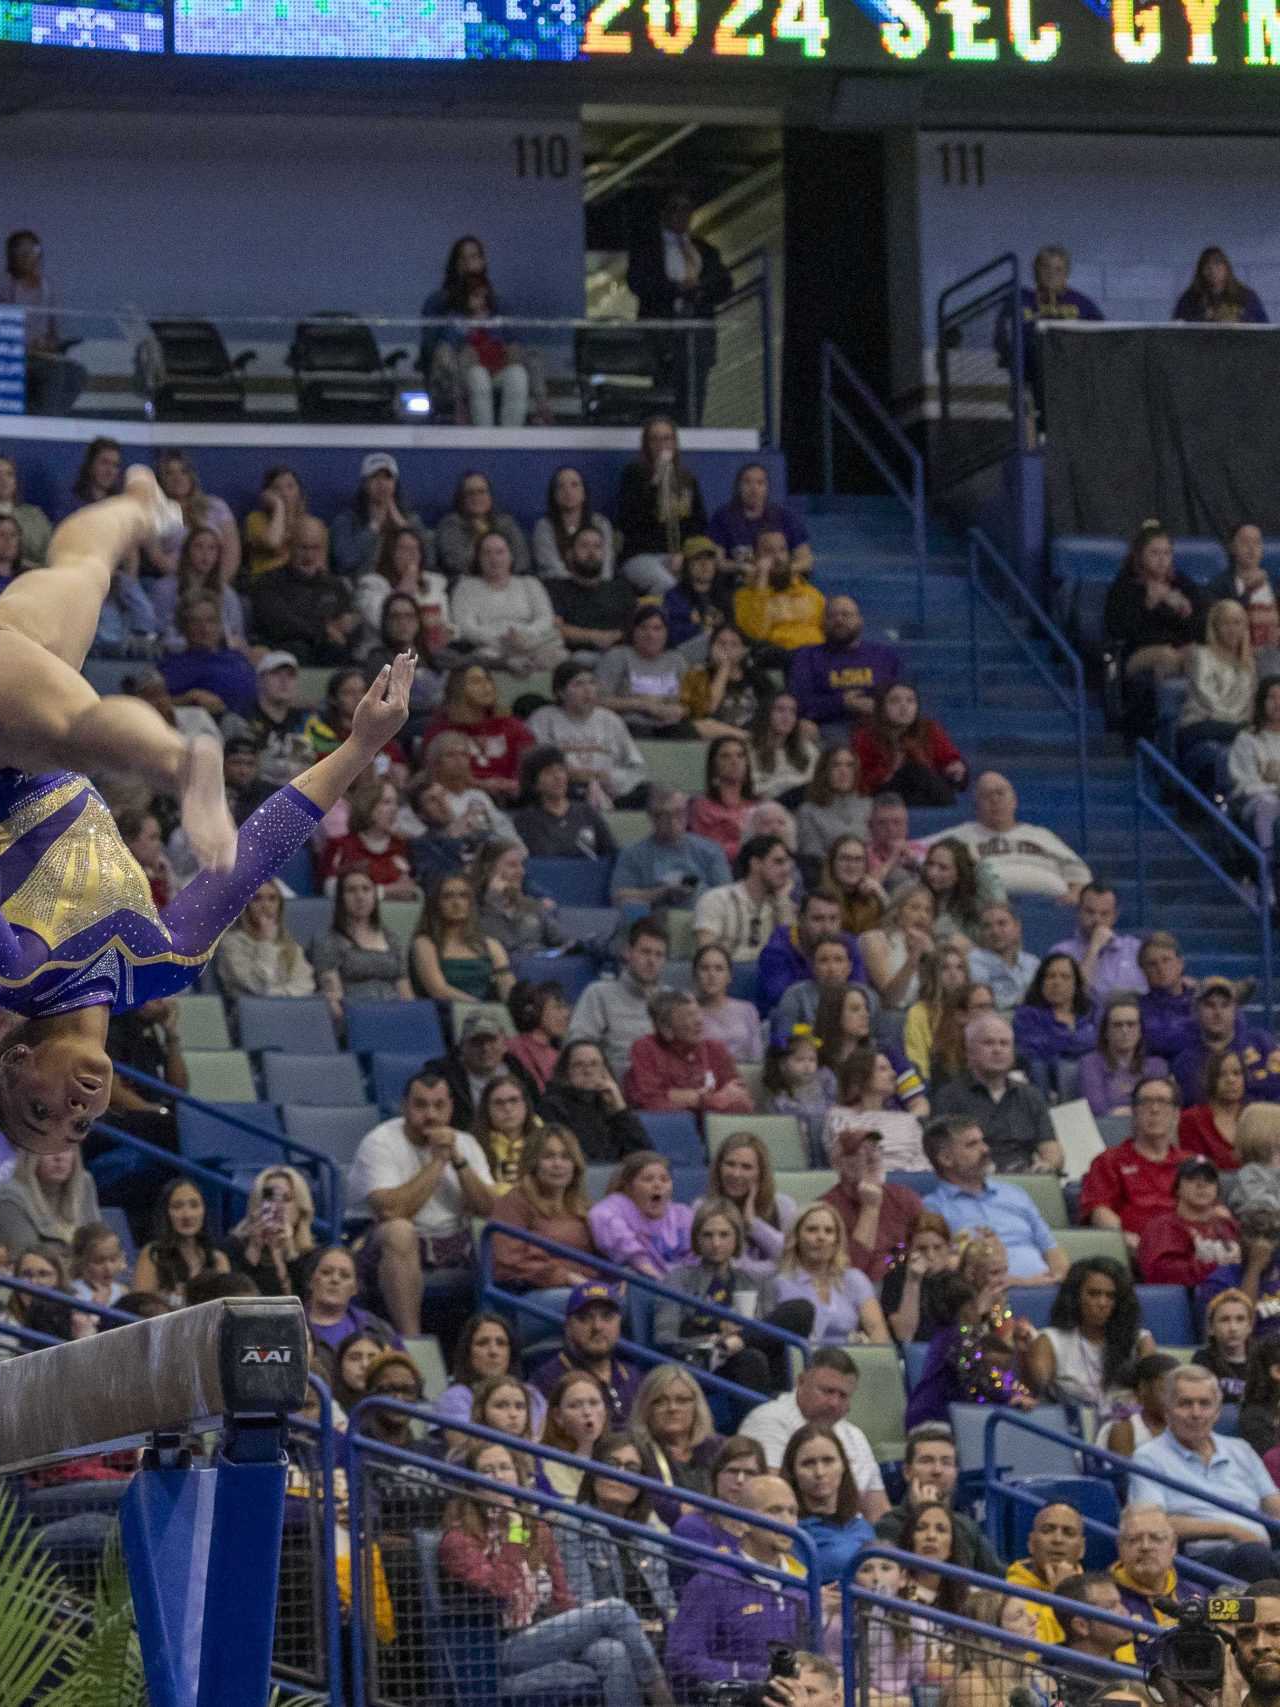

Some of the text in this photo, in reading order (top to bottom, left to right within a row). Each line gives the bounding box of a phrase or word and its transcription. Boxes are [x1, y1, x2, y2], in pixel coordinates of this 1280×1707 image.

[581, 0, 829, 57] 2024
[880, 0, 1061, 62] SEC
[512, 134, 568, 178] 110
[937, 143, 984, 186] 111
